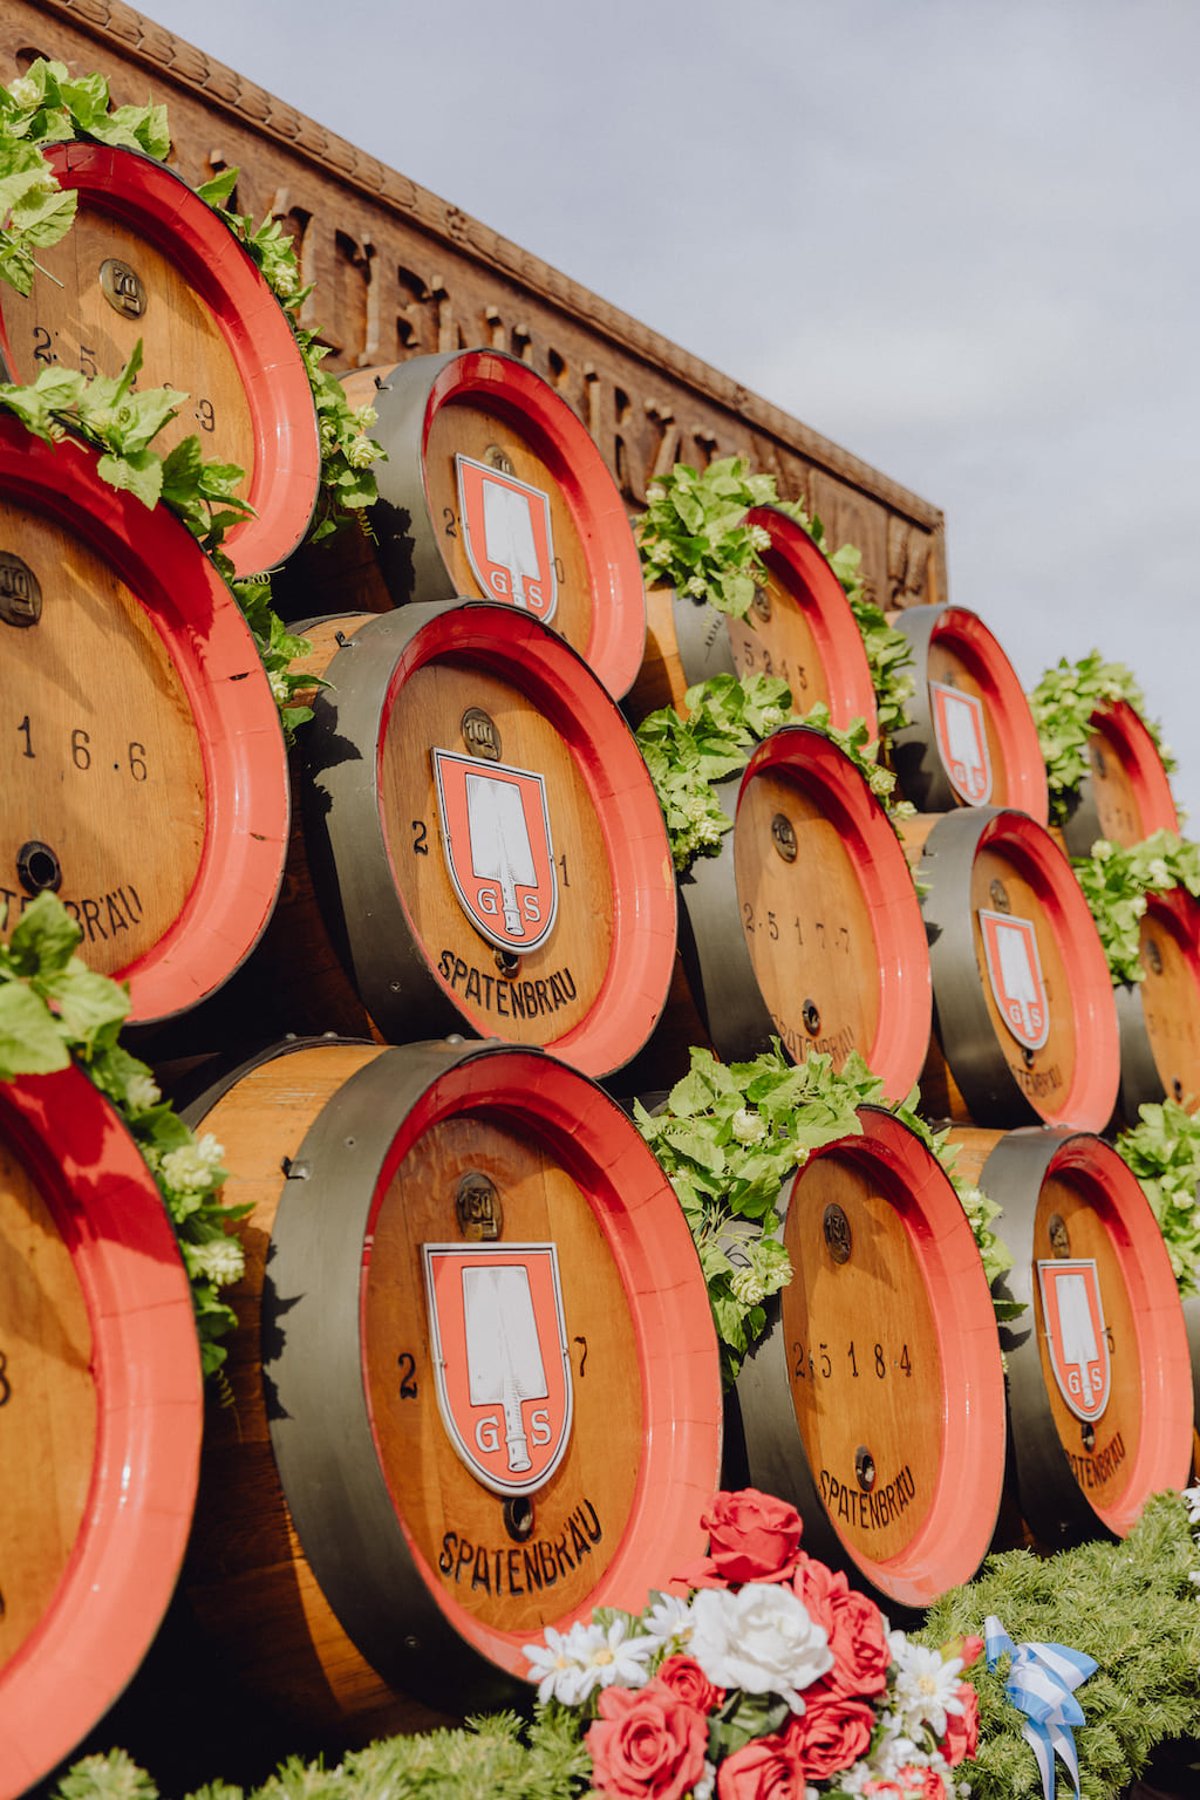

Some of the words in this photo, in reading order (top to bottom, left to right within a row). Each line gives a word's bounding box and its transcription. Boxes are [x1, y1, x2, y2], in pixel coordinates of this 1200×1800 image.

[490, 570, 509, 594] G
[529, 585, 544, 608] S
[411, 820, 428, 855] 2
[477, 888, 499, 914] G
[523, 895, 541, 922] S
[438, 950, 578, 1019] SPATENBRÄU
[1009, 1003, 1023, 1025] G
[1030, 1007, 1043, 1028] S
[398, 1353, 418, 1399] 2
[573, 1336, 588, 1377] 7
[1068, 1371, 1081, 1395] G
[1091, 1367, 1103, 1392] S
[474, 1416, 501, 1452] G
[531, 1410, 552, 1447] S
[819, 1465, 916, 1529] SPATENBRÄU
[439, 1498, 602, 1597] SPATENBRÄU
